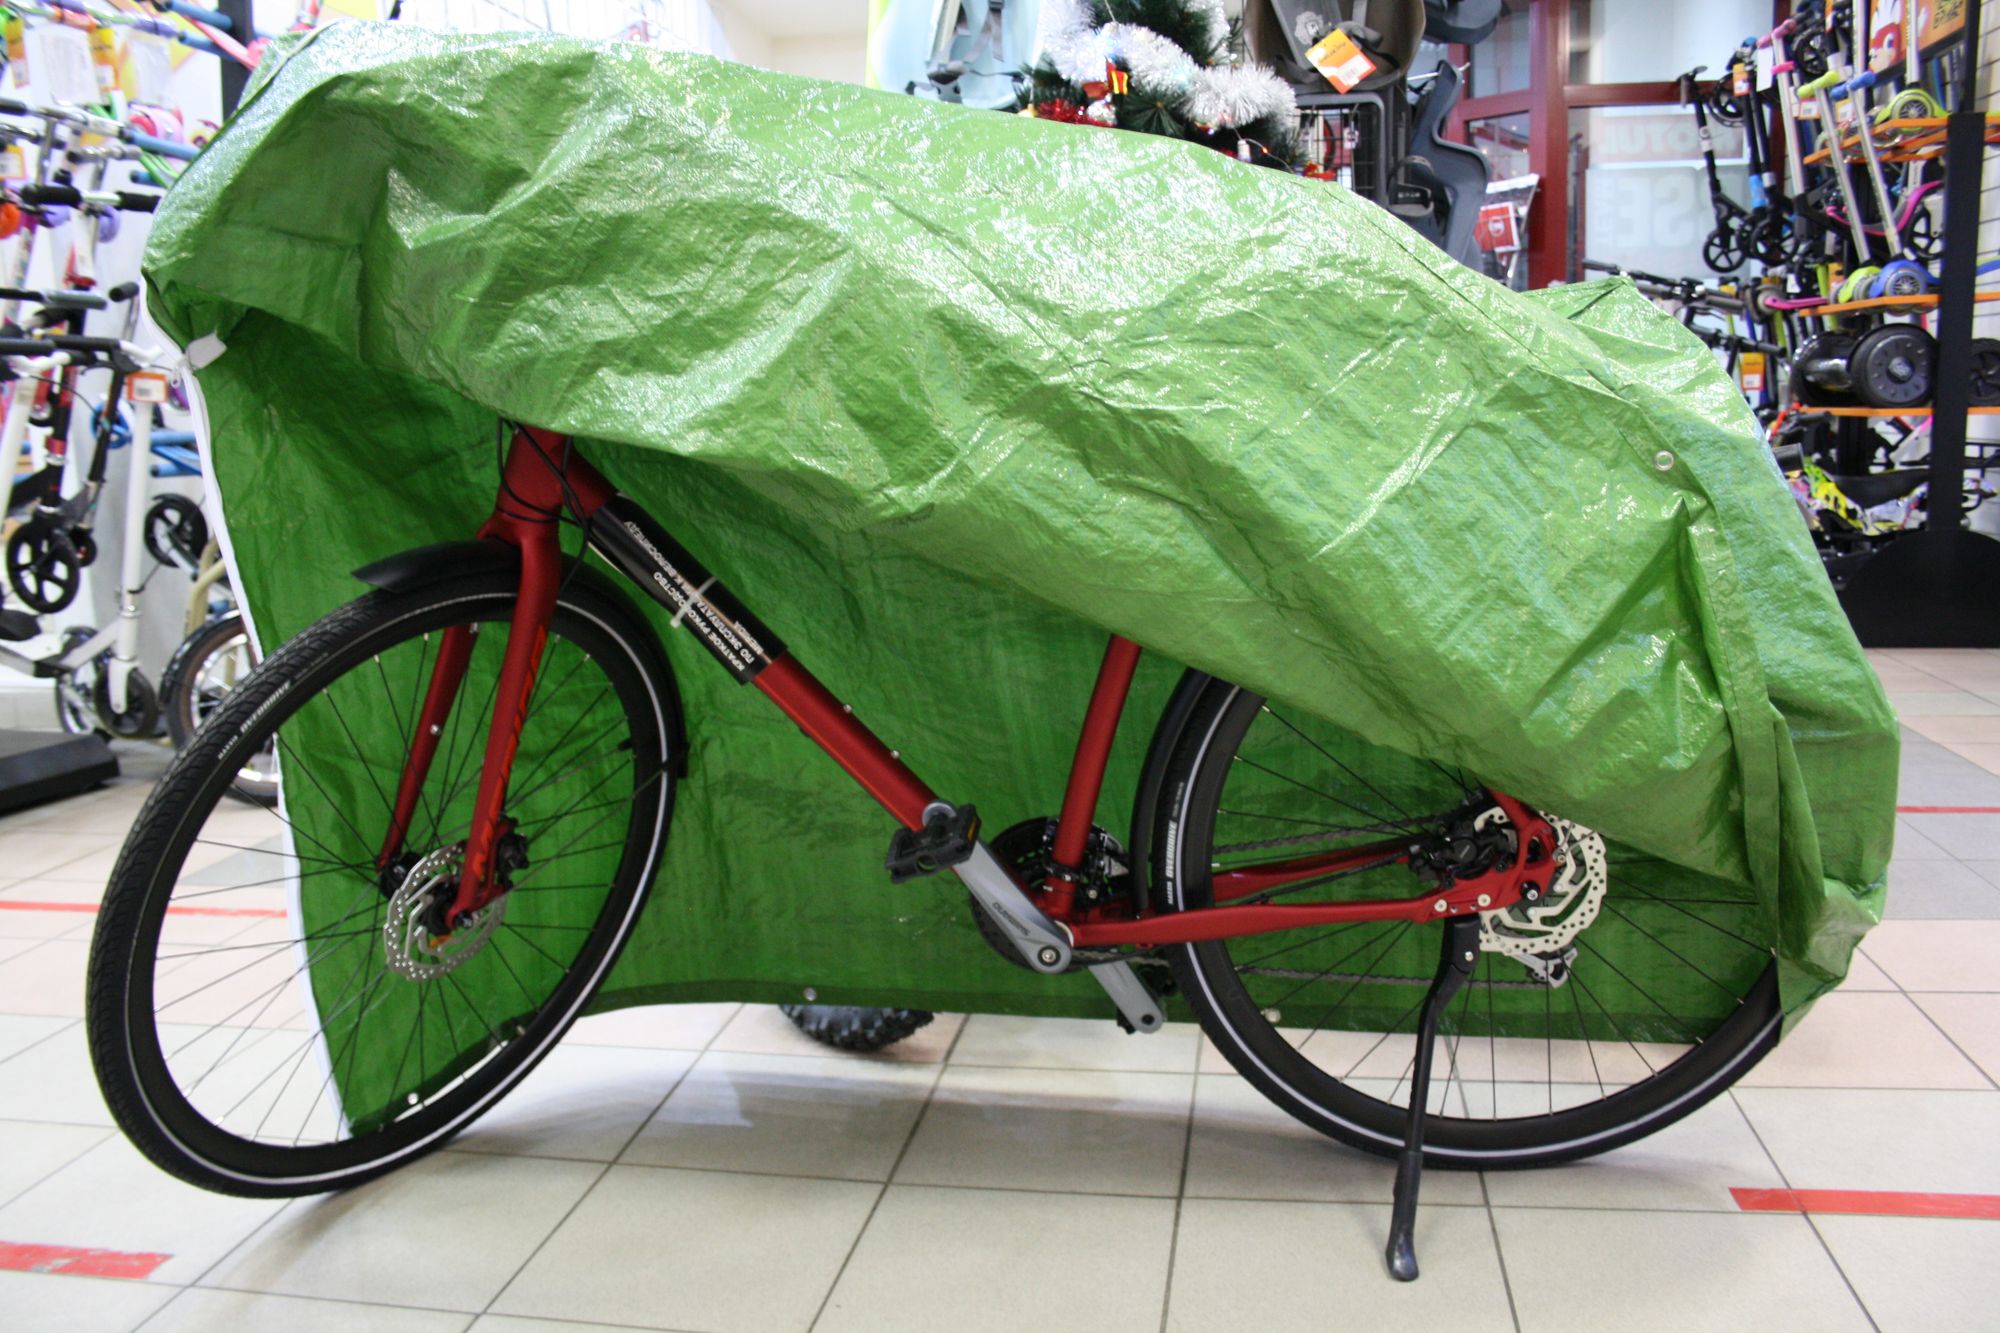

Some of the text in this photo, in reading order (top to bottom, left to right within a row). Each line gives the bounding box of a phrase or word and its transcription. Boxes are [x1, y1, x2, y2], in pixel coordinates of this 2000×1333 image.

[624, 521, 677, 577] ВЕЛОСИПЕДУ
[653, 571, 746, 672] КРАТКОЕ РУКООДСТВО
[680, 581, 743, 650] ЭКСПЛУАТАИИ
[739, 648, 755, 664] ПО
